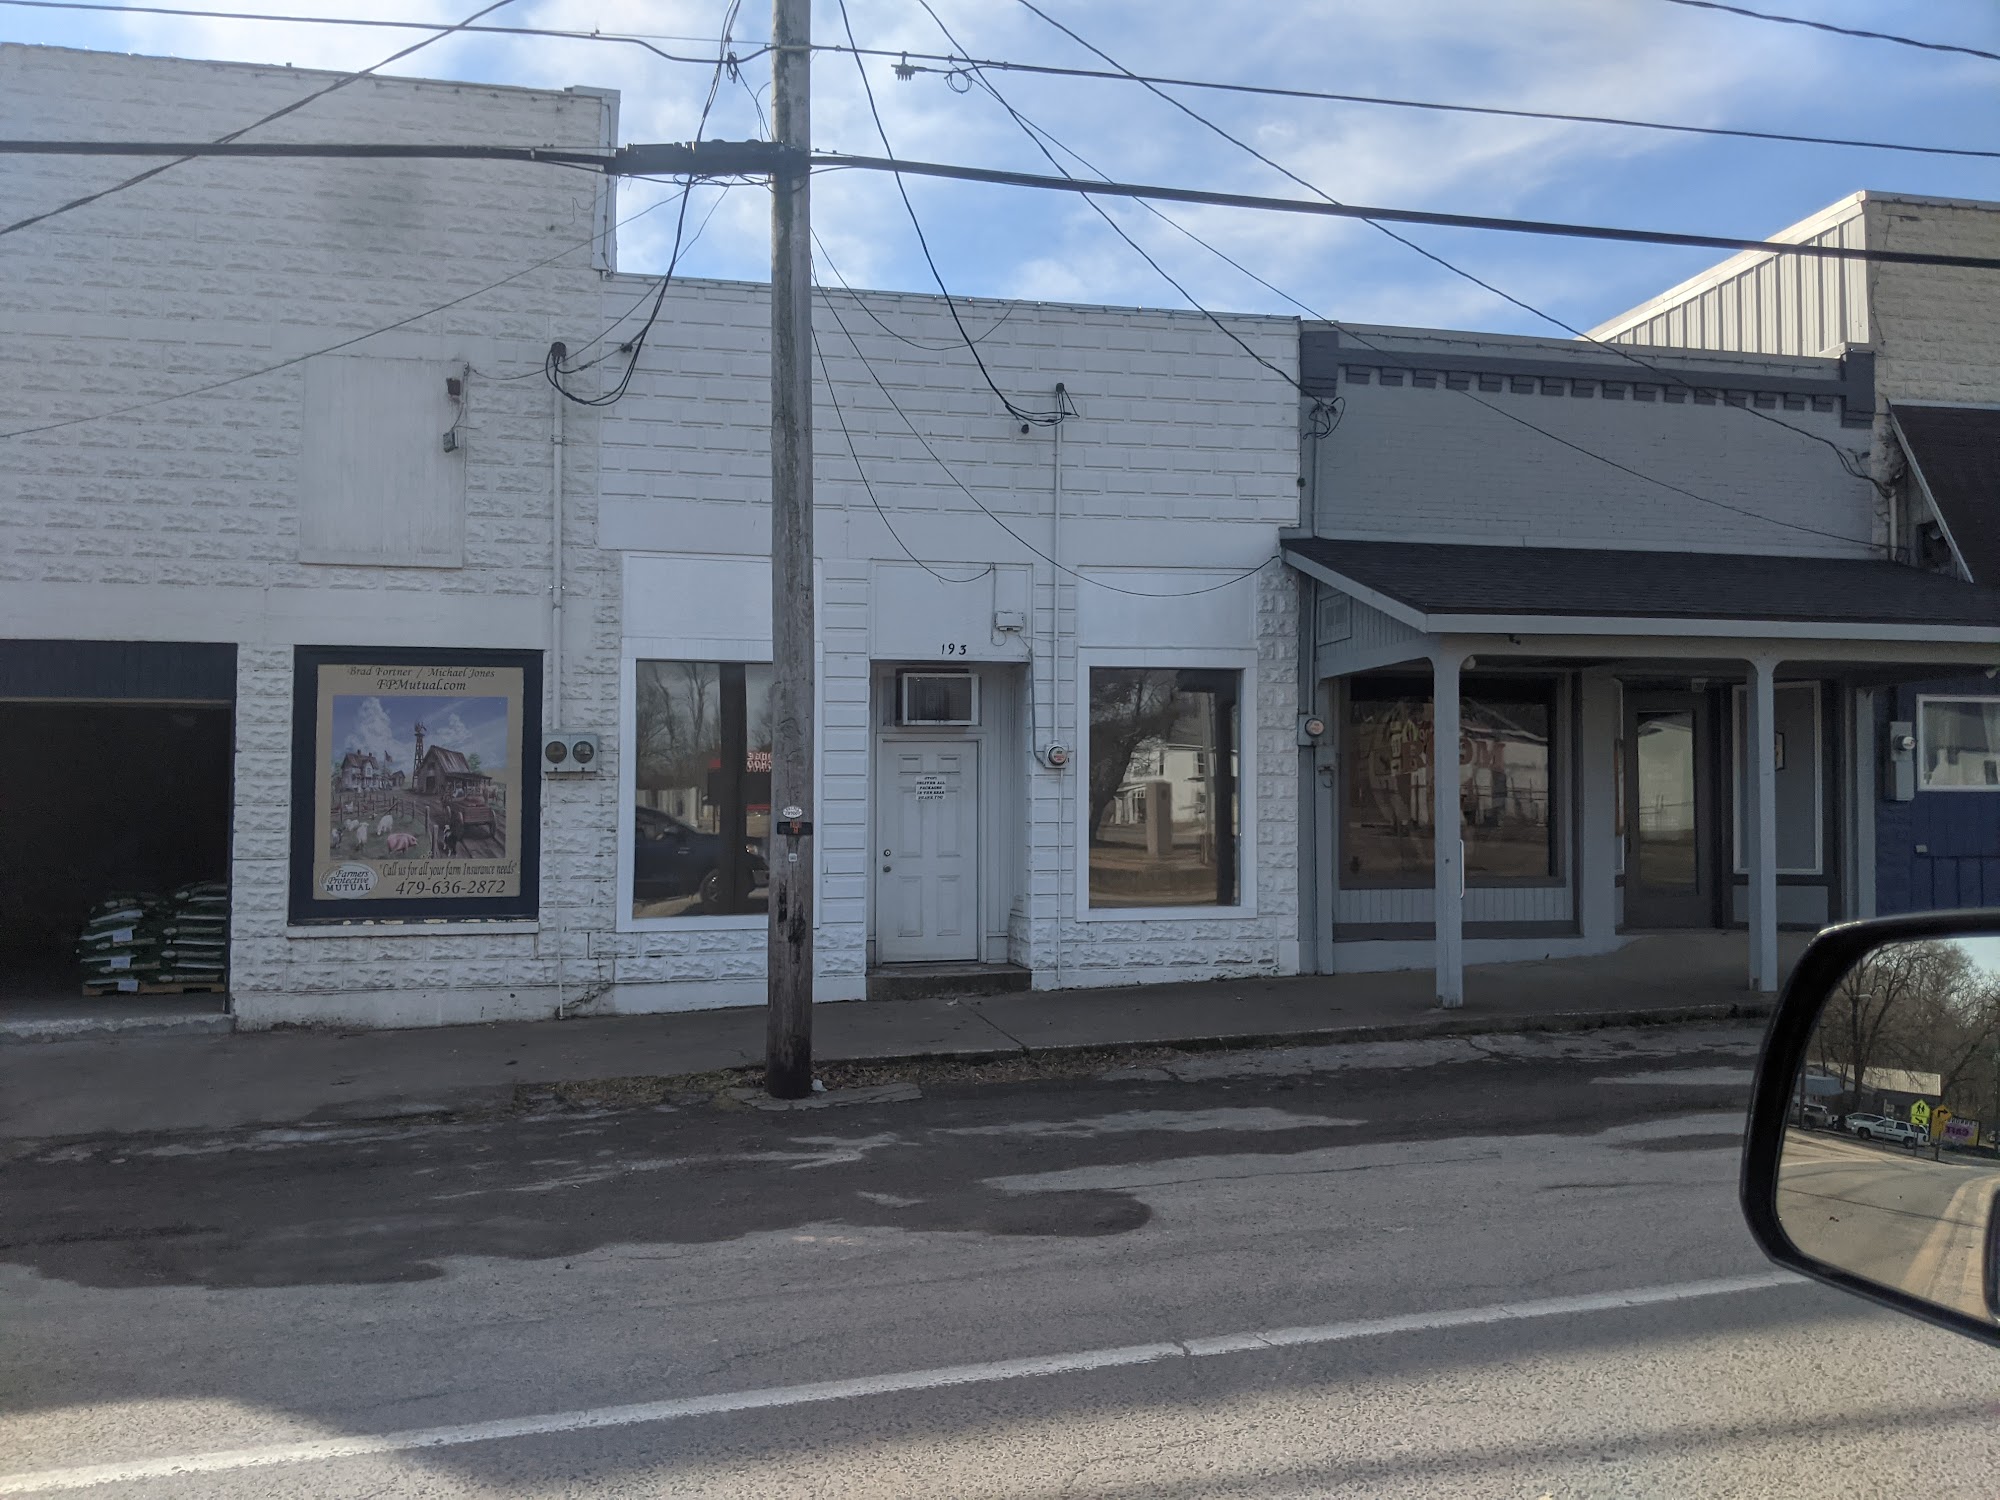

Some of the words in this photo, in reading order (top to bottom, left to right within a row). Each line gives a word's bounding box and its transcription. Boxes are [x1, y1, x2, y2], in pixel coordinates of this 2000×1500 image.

[941, 643, 967, 656] 193
[348, 666, 372, 676] Brad
[375, 667, 412, 677] Fortner
[427, 667, 466, 677] Michael
[468, 668, 495, 678] Jones
[377, 678, 466, 691] FPMutual.com
[335, 870, 370, 878] Farmers
[399, 866, 406, 876] us
[405, 862, 417, 880] for
[419, 862, 429, 876] all
[428, 866, 444, 880] your
[443, 861, 461, 880] farm
[463, 863, 495, 876] Insurance
[327, 876, 370, 885] Protective
[395, 880, 506, 895] 479-636-2872
